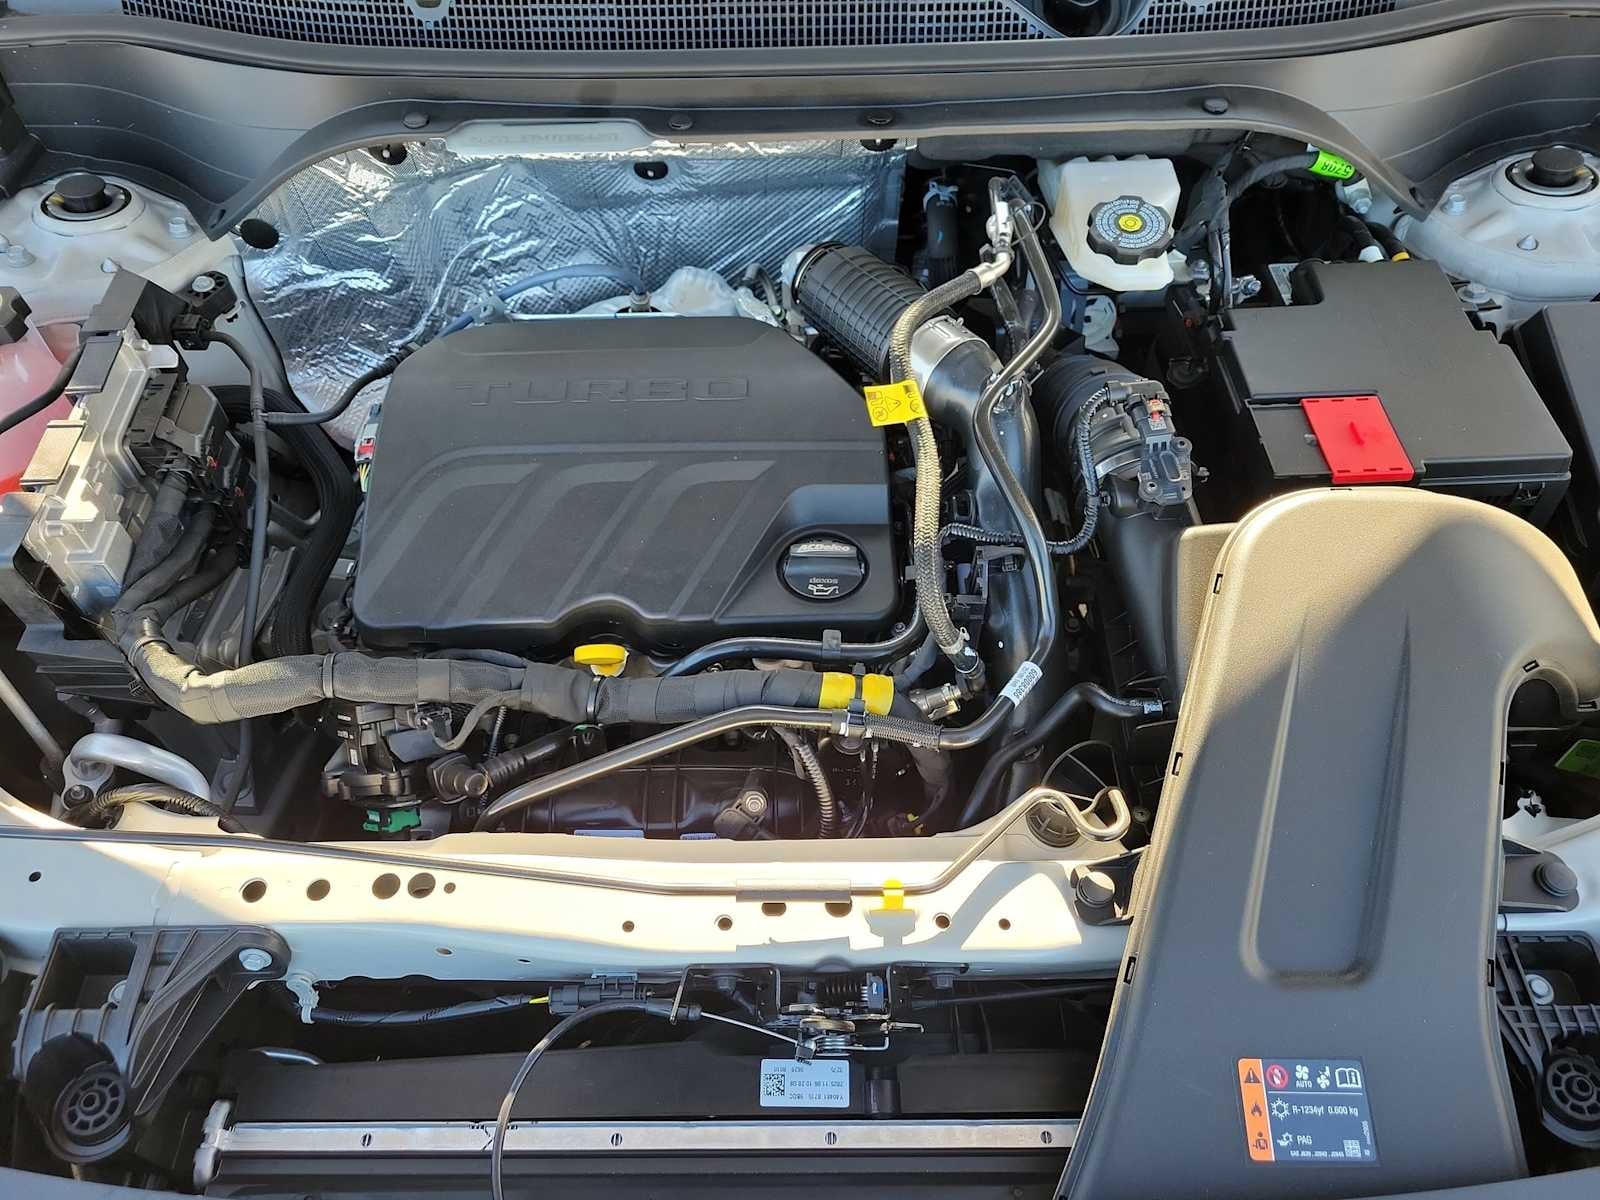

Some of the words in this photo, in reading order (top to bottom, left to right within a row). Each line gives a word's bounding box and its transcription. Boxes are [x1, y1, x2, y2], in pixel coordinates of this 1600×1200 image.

[455, 377, 749, 406] TURBO
[797, 544, 850, 553] ACDelco
[1296, 1080, 1313, 1088] AUTO
[1292, 1105, 1325, 1117] R-1234yf
[1349, 1106, 1359, 1117] kg
[1296, 1136, 1313, 1145] PAG
